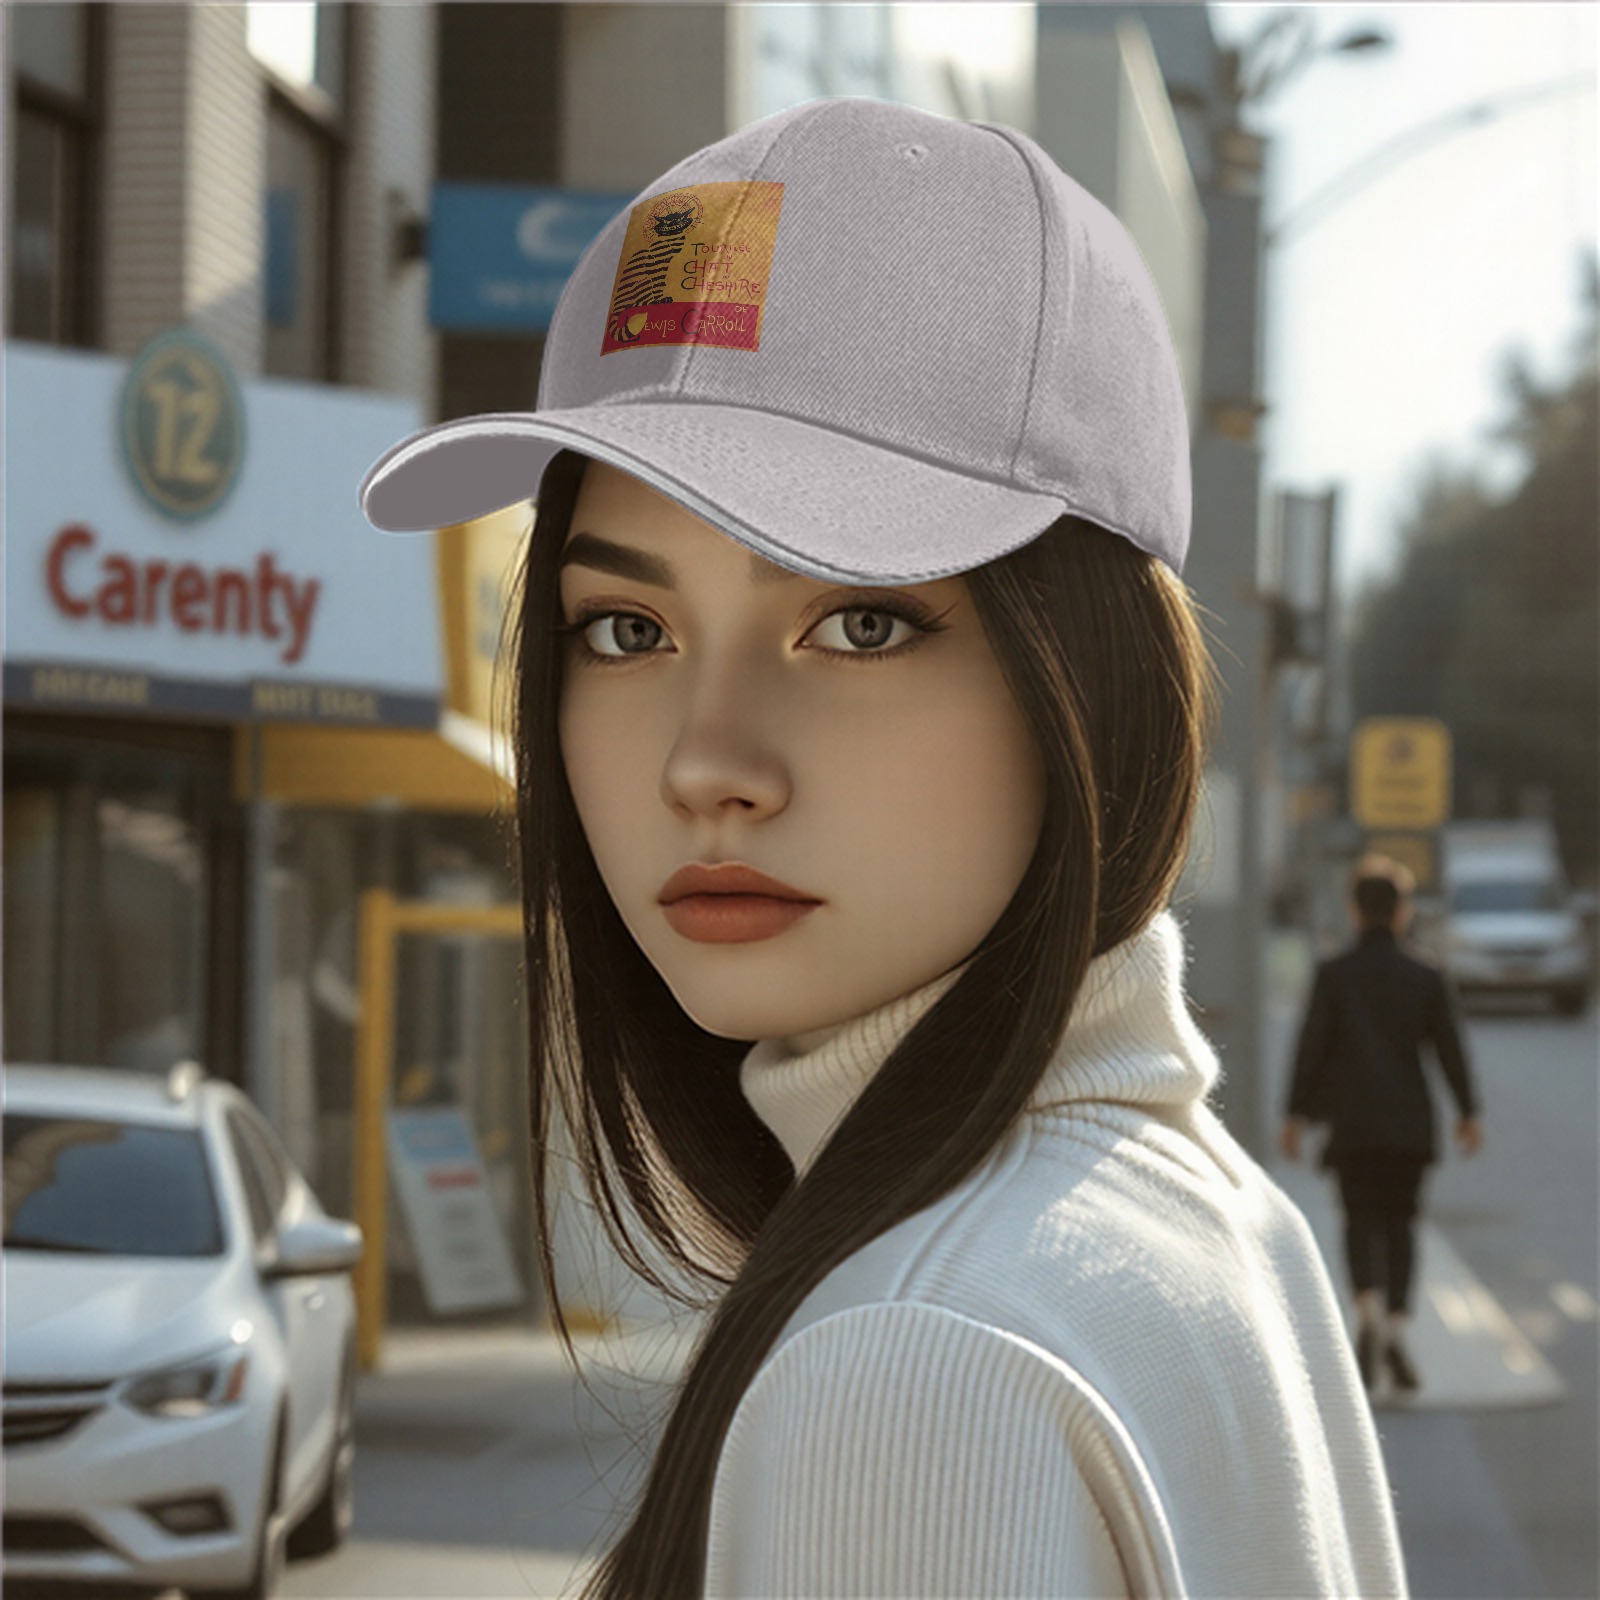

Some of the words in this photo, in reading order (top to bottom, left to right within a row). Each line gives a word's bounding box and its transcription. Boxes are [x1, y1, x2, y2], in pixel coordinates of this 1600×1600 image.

[681, 276, 761, 300] CHESHIRE
[681, 308, 747, 336] CARROLL
[44, 522, 321, 666] Carenty
